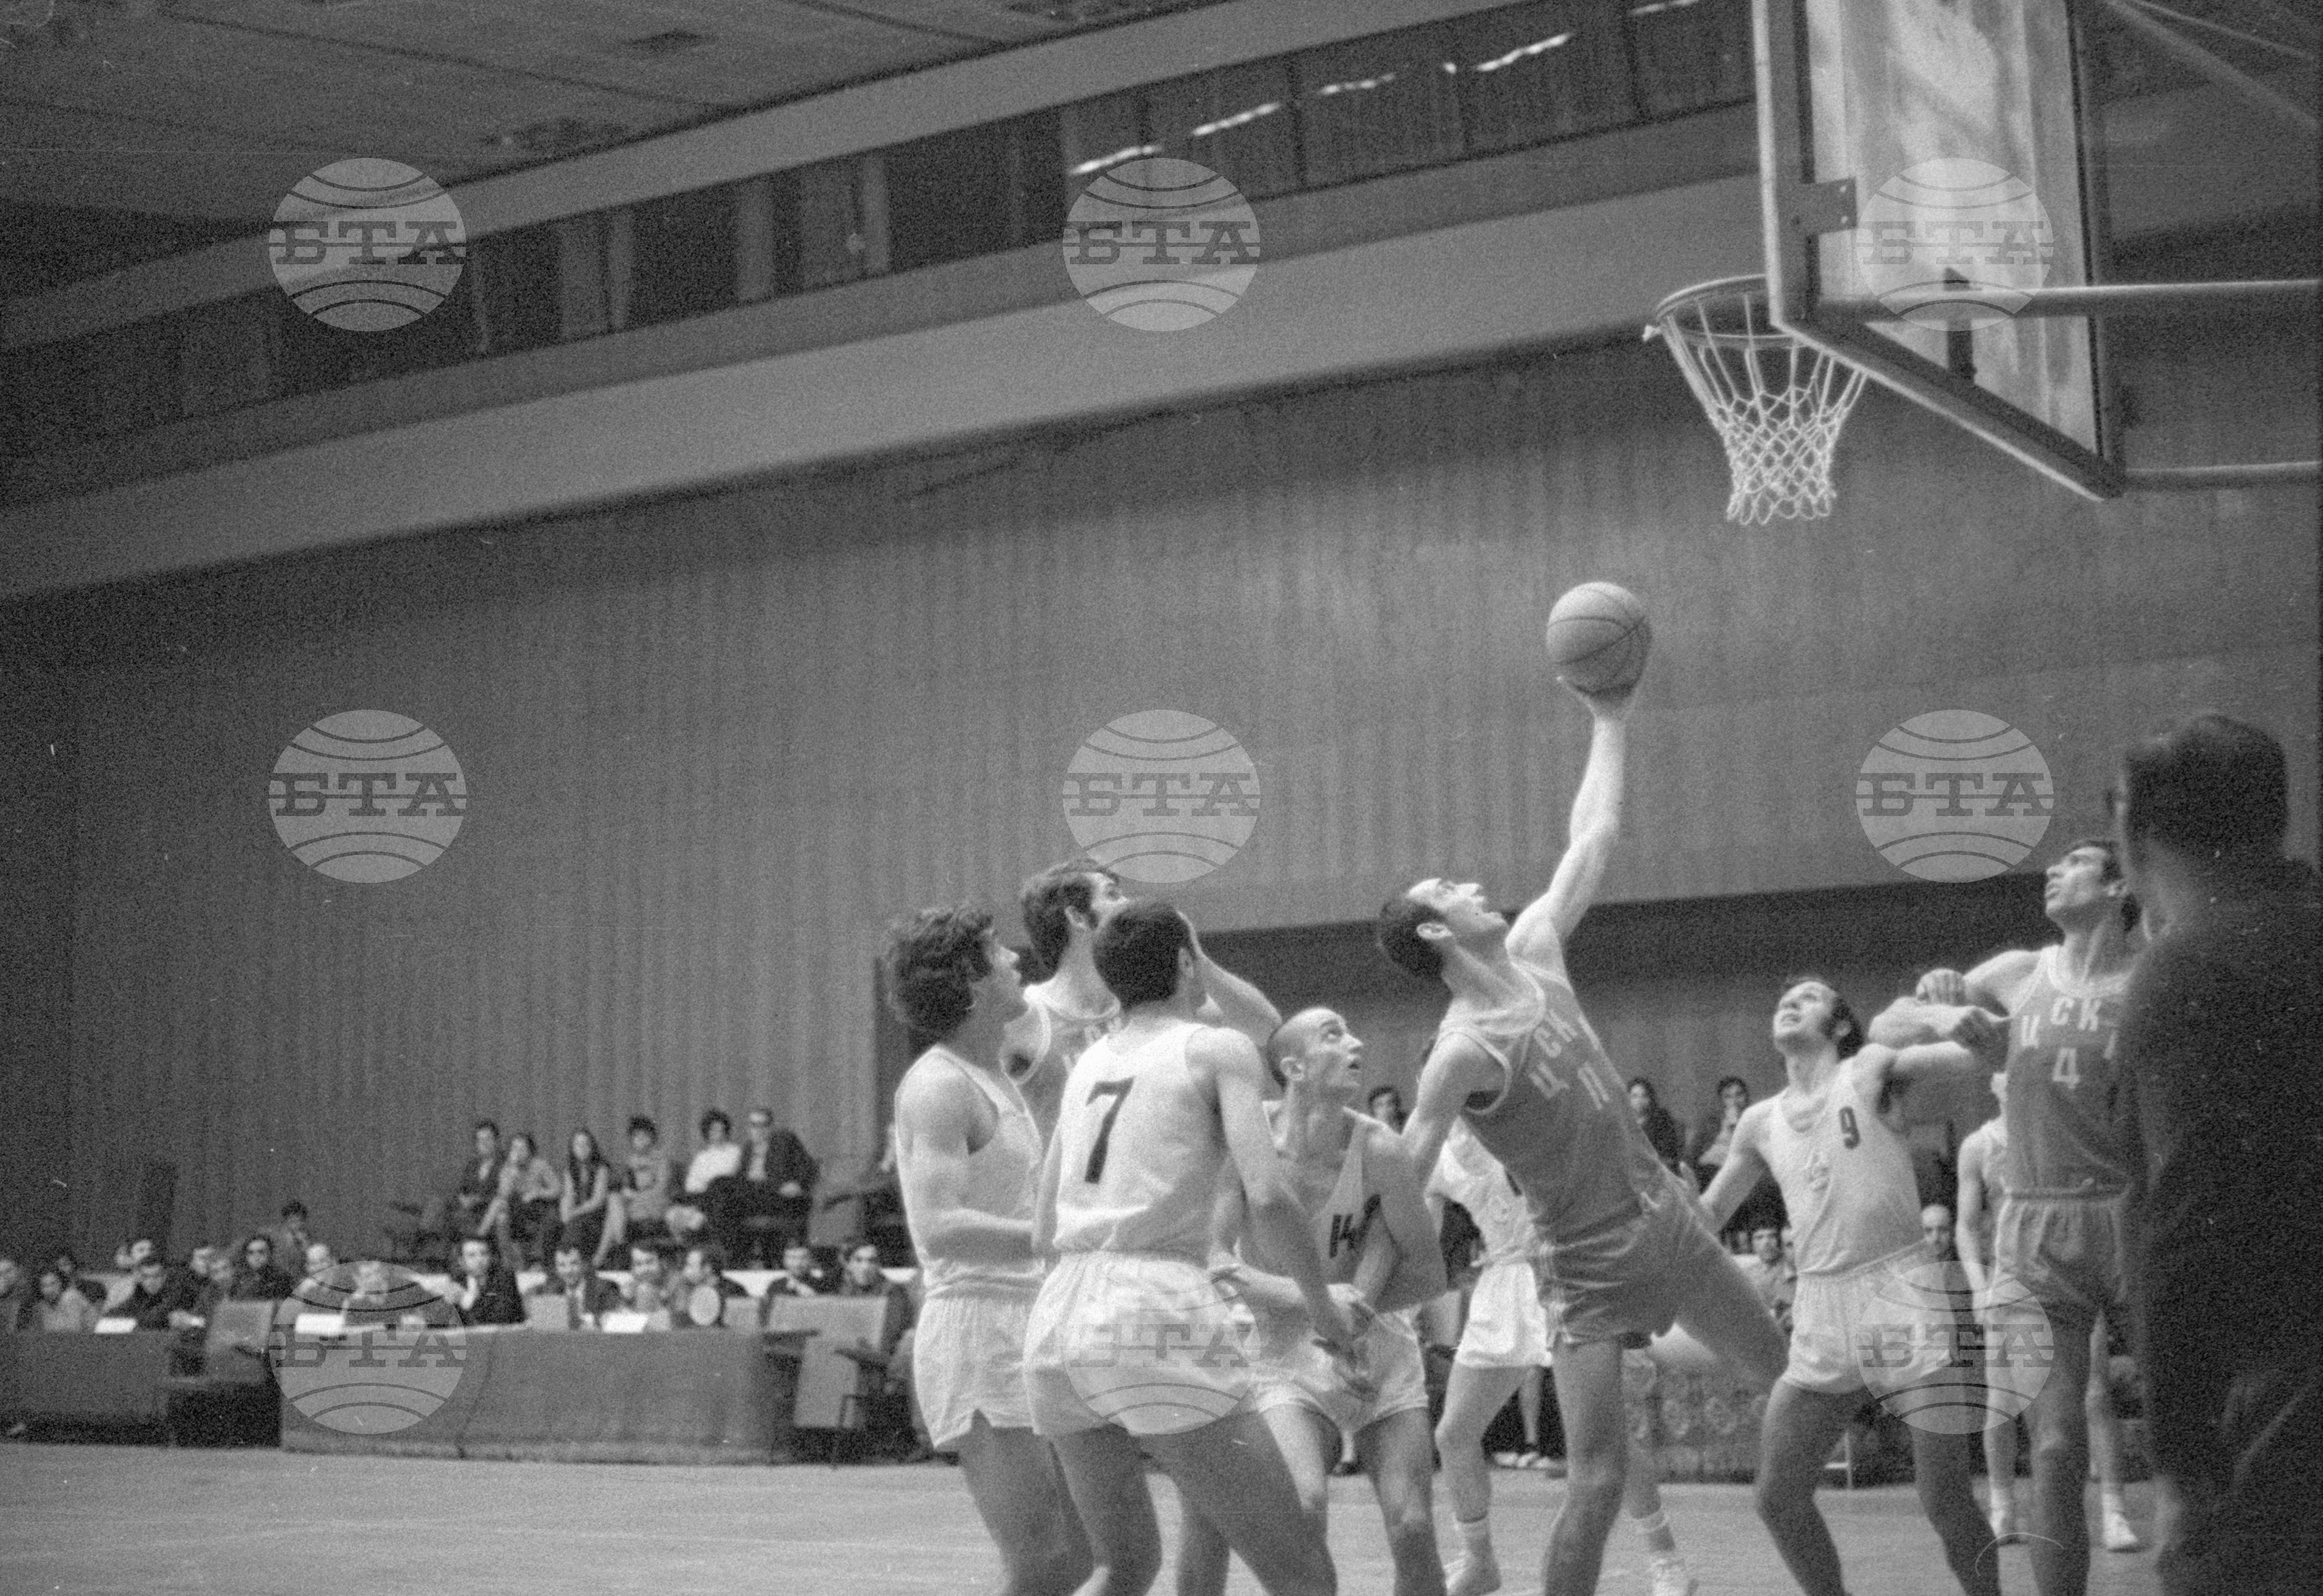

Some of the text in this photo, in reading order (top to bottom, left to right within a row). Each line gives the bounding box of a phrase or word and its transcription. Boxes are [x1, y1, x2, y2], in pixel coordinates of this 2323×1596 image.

[2052, 1047, 2080, 1089] 4
[1084, 1076, 1134, 1185] 7
[1839, 1106, 1861, 1150] 9
